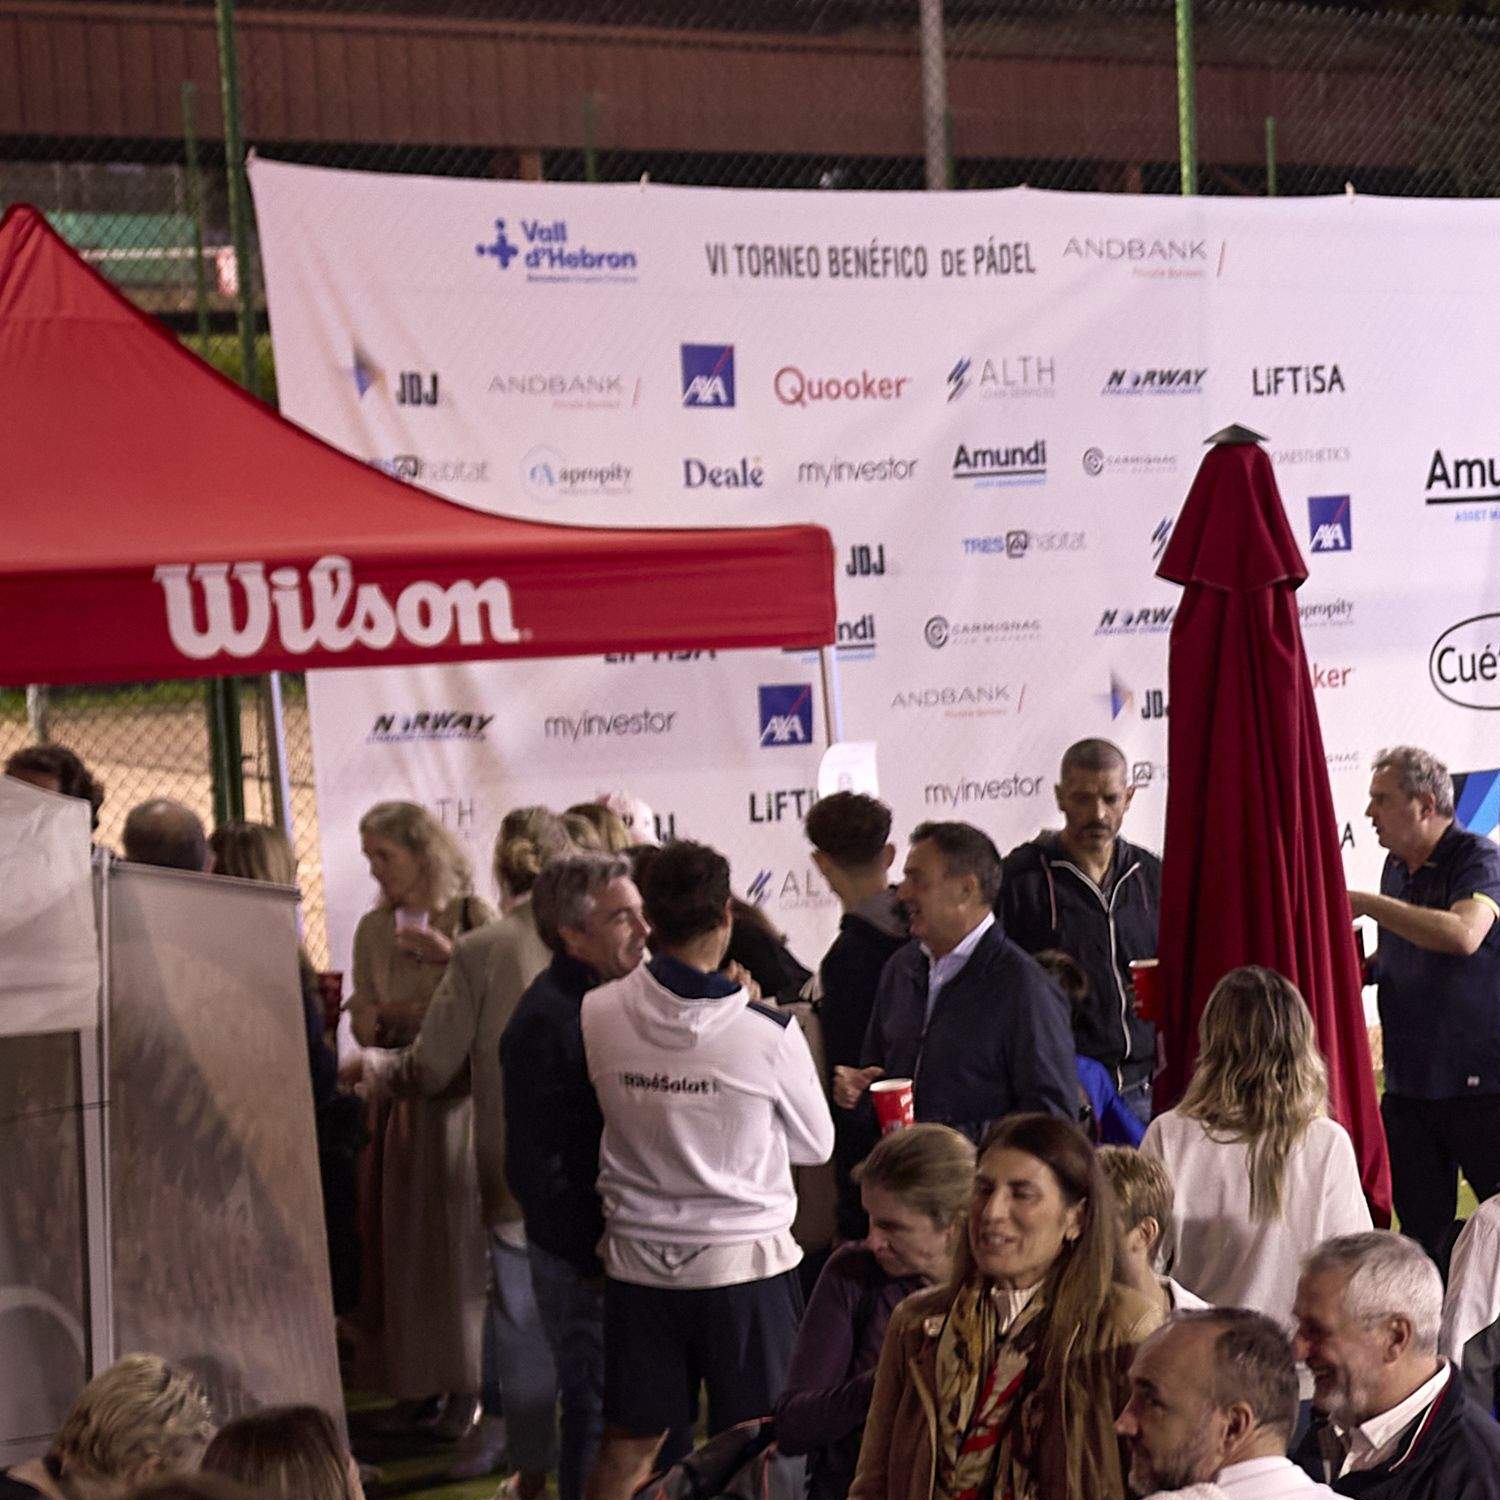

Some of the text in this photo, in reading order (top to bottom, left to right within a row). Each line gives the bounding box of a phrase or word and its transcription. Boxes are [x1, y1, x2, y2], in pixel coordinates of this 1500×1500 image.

[521, 219, 567, 243] Vall
[525, 247, 637, 269] d'Hebron
[706, 236, 1036, 278] VI TORNEO BENÉFICO DE PÁDEL
[1063, 237, 1207, 260] ANDBANK
[488, 374, 624, 394] ANDBANK
[774, 365, 905, 407] Quooker
[980, 356, 1056, 387] ALTH
[682, 376, 729, 407] AXA
[954, 440, 1047, 468] Amundi
[799, 456, 918, 485] myinvestor
[1308, 523, 1346, 550] AXA
[153, 555, 521, 660] Wilson
[837, 615, 876, 641] ndi
[891, 683, 1011, 709] ANDBANK
[544, 709, 677, 742] myinvestor
[760, 711, 806, 746] AXA
[925, 773, 1044, 808] myinvestor
[437, 798, 474, 828] TH
